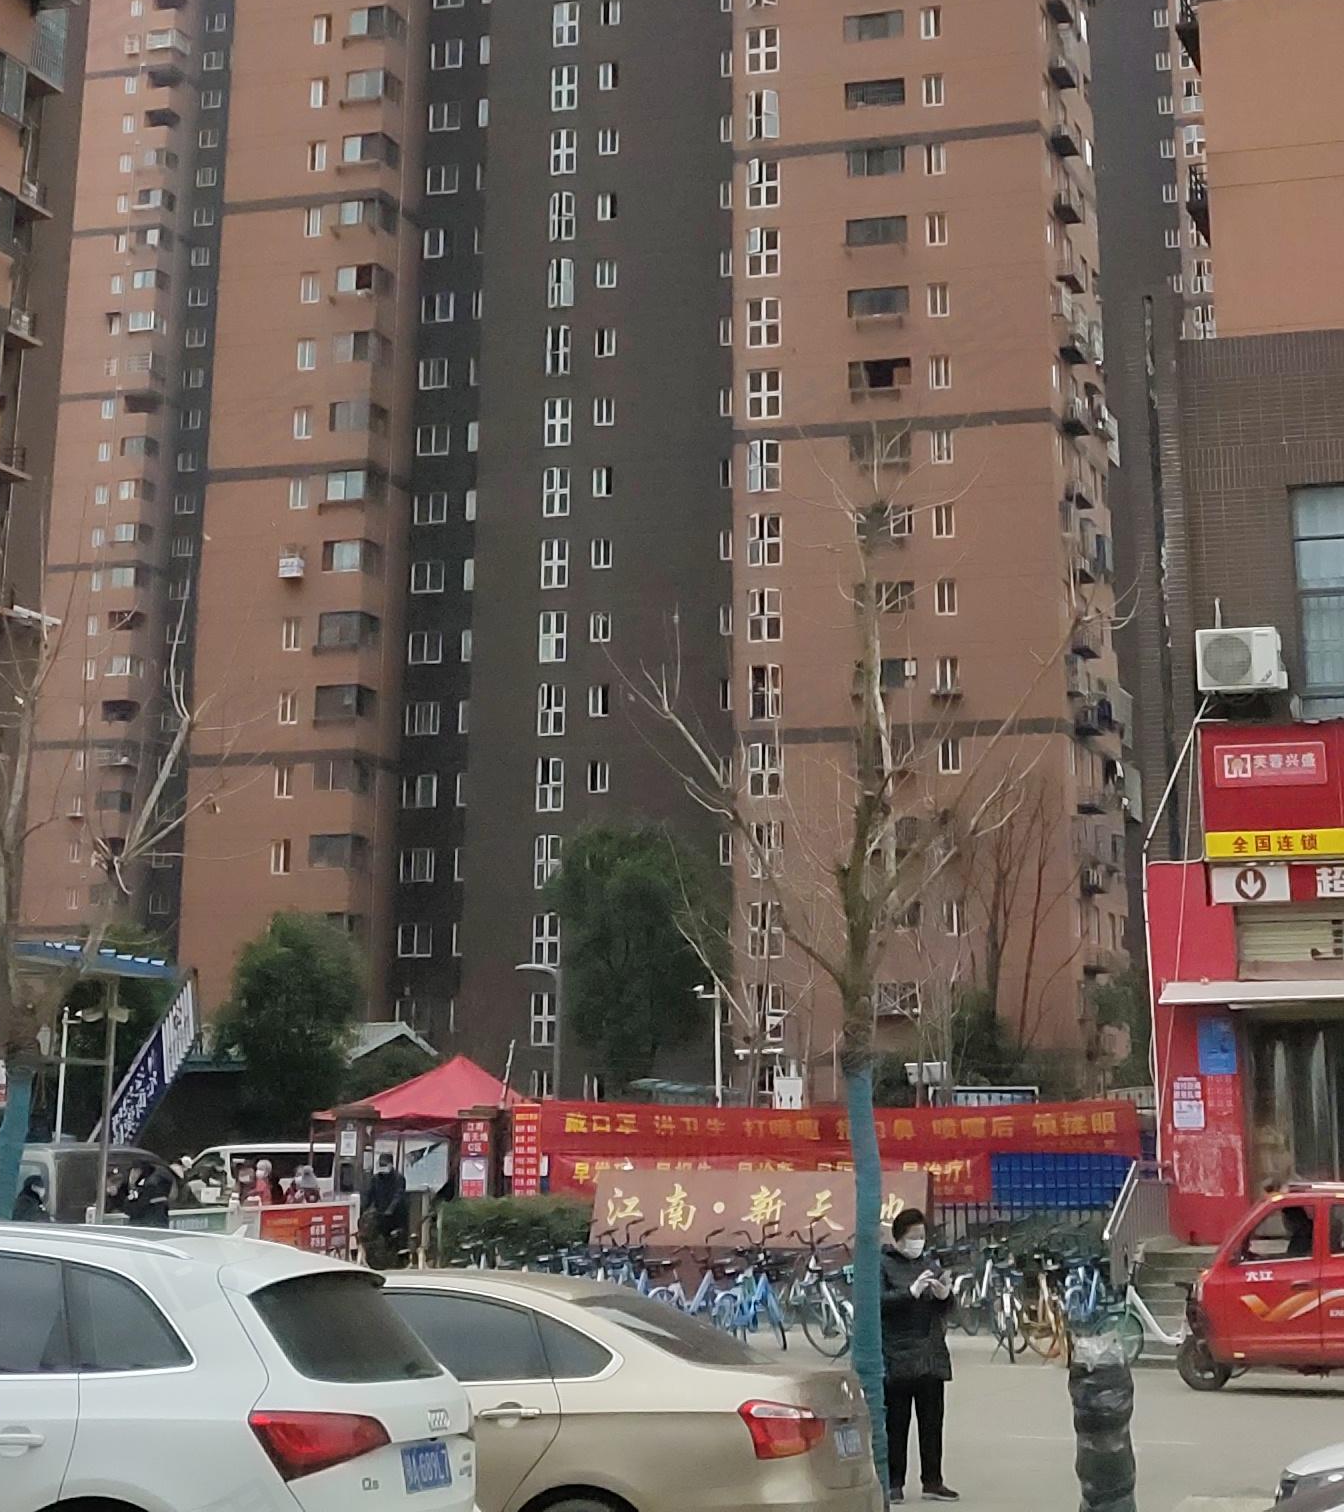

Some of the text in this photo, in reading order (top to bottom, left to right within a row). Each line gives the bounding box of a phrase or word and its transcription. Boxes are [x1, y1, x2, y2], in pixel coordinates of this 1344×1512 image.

[1253, 753, 1317, 769] 芙蓉兴盛
[1232, 833, 1320, 854] 全国连锁
[564, 1112, 640, 1135] 戴口罩
[653, 1114, 726, 1137] 讲卫生
